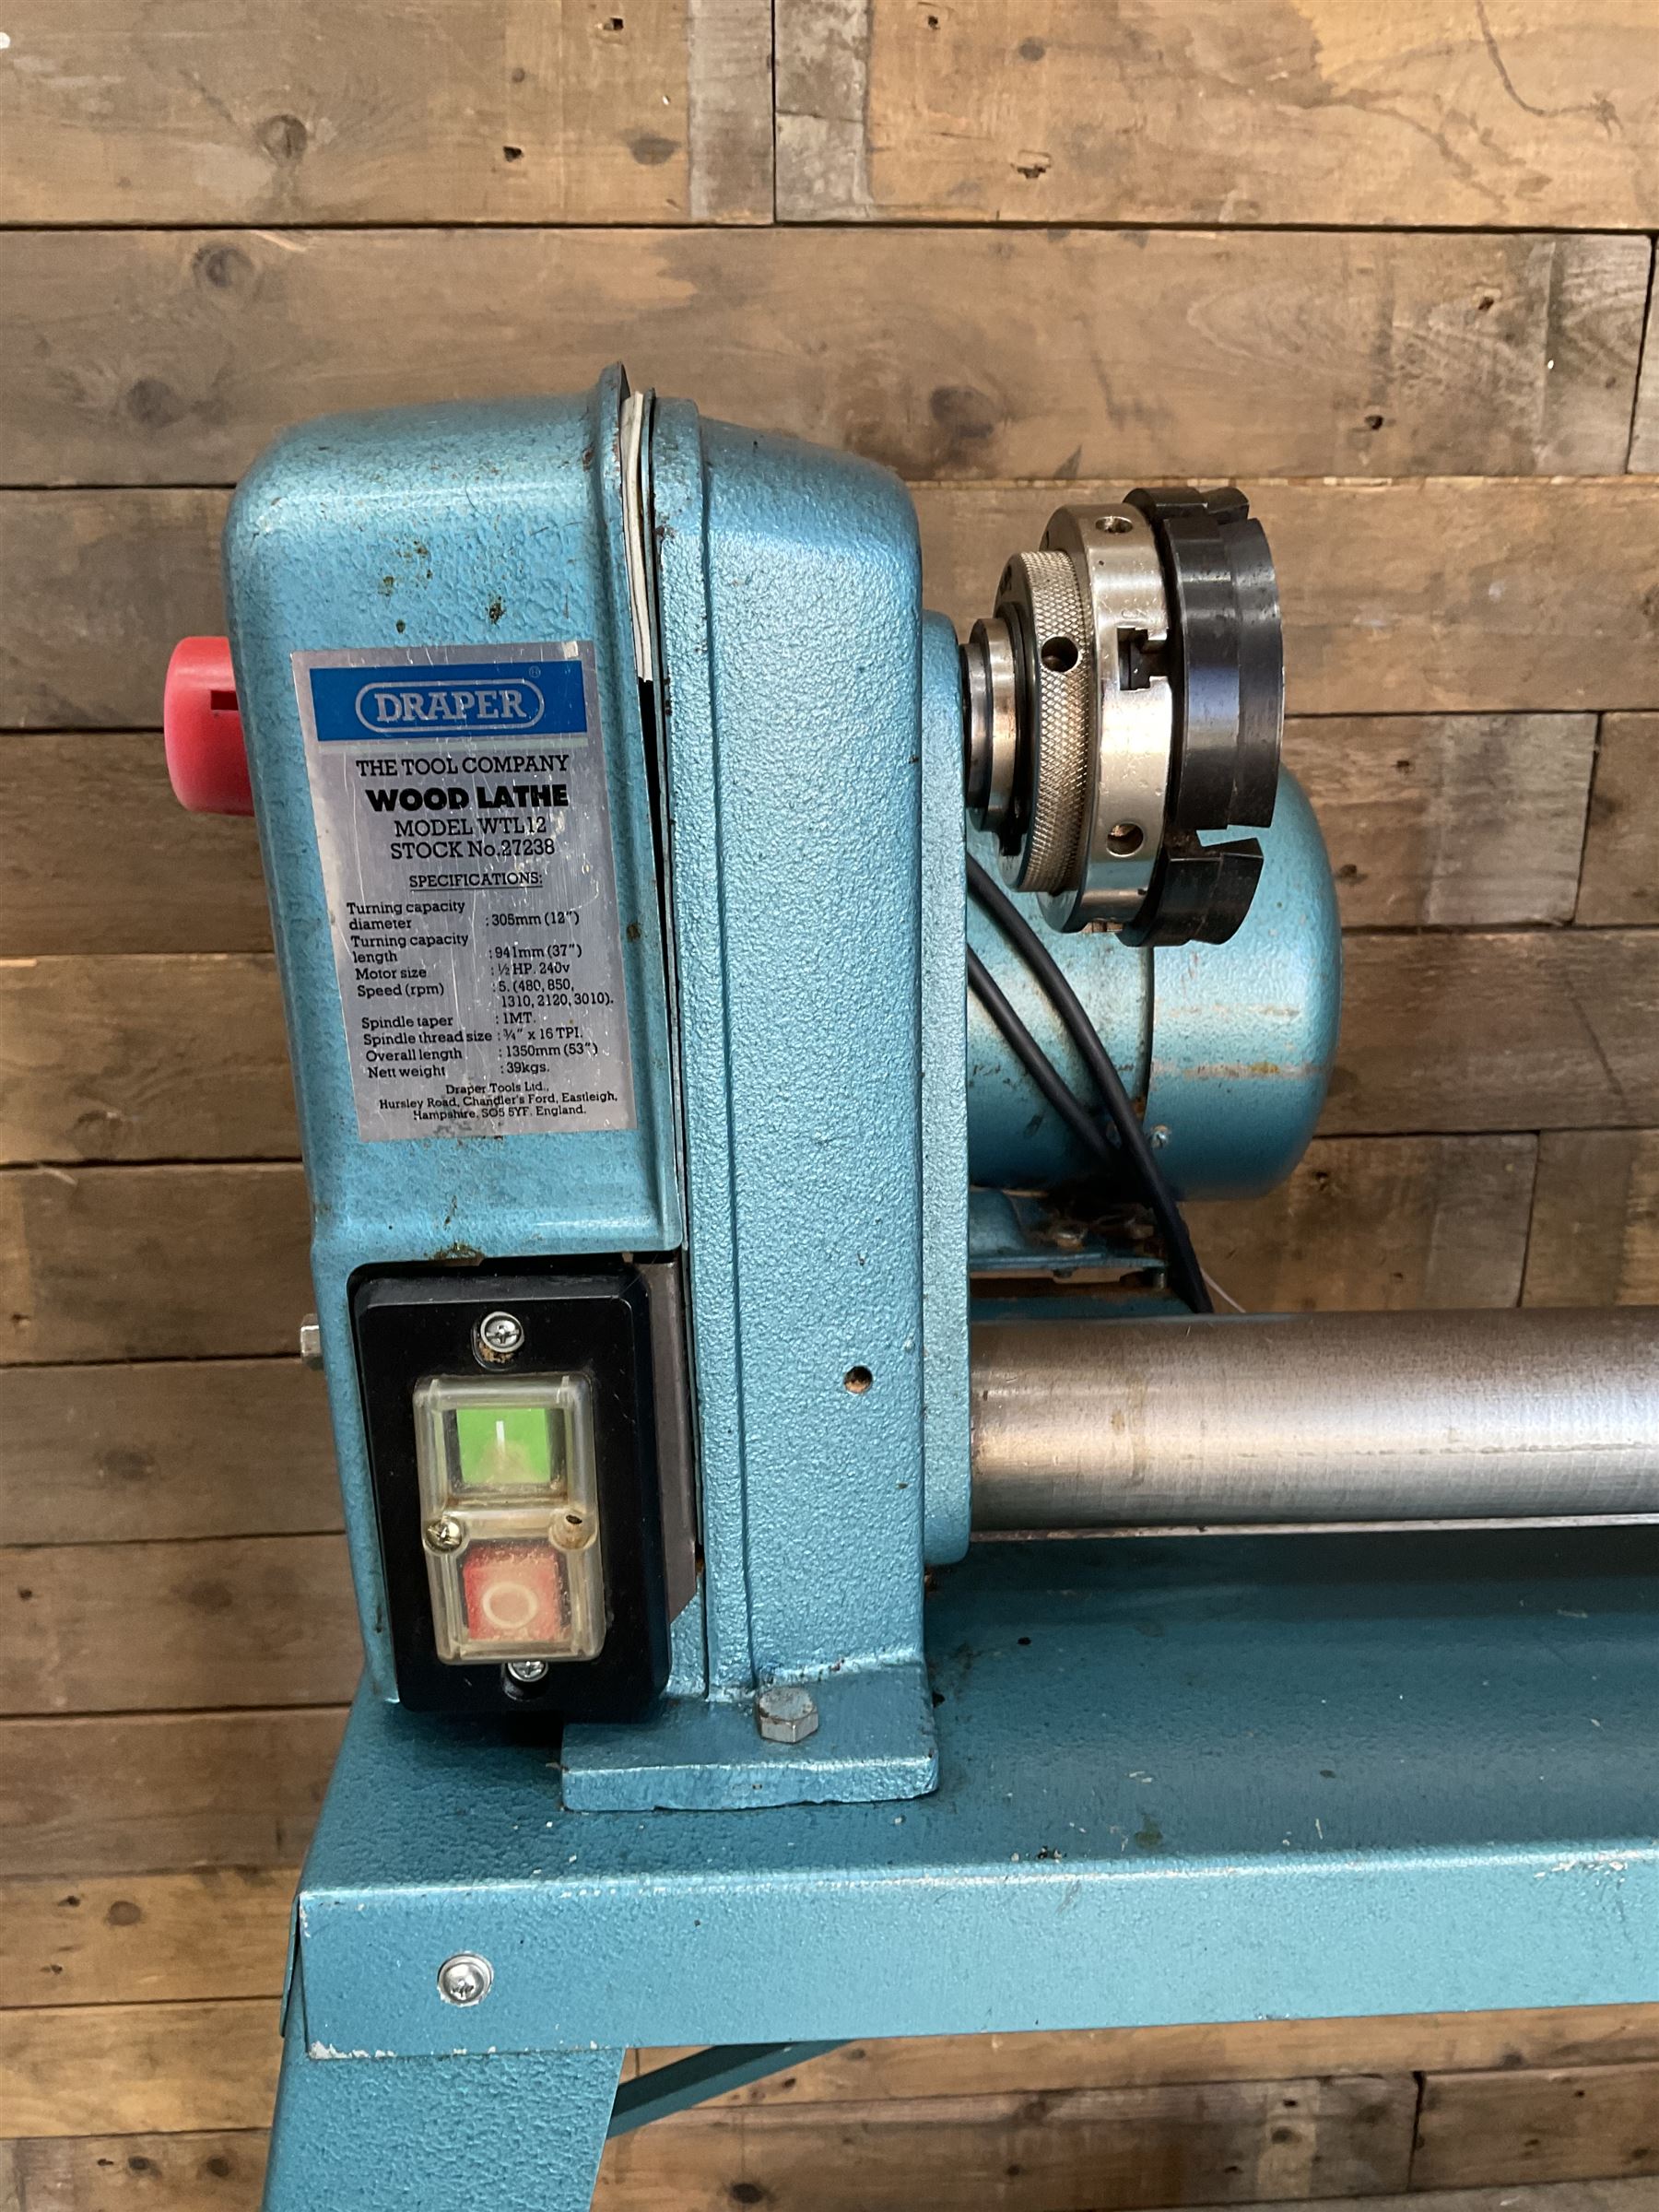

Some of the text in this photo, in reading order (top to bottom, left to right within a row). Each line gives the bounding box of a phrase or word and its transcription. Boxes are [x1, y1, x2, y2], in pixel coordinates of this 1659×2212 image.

[373, 689, 528, 723] DRAPER
[356, 754, 570, 777] THE TOOL COMPANY
[365, 783, 569, 812] WOOD LATHE
[394, 818, 474, 838] MODEL
[390, 841, 463, 860] STOCK
[409, 871, 543, 888] SPECIFICATIONS:
[347, 900, 465, 914] Turning capacity
[348, 917, 412, 931] diameter
[491, 912, 542, 926] 305mm
[350, 932, 469, 948] Turning capacity
[352, 949, 398, 965] length
[495, 946, 545, 959] 941mm
[355, 967, 397, 981] Motor
[400, 966, 427, 979] size
[539, 961, 571, 975] 240v
[357, 982, 403, 999] Speed
[405, 982, 444, 998] (rpm)
[512, 979, 545, 994] (480,
[547, 978, 574, 992] 850,
[501, 992, 615, 1008] 1310, 2120, 3010).
[361, 1016, 415, 1031] Spindle
[417, 1016, 453, 1030] taper
[363, 1032, 417, 1048] Spindle
[418, 1031, 465, 1044] thread
[465, 1030, 493, 1042] size
[527, 1030, 536, 1041] x
[539, 1028, 554, 1040] 16
[555, 1026, 583, 1039] TPI.
[365, 1049, 417, 1063] Overall
[418, 1047, 463, 1062] length
[506, 1044, 561, 1058] 1350mm
[368, 1066, 396, 1079] Nett
[398, 1065, 446, 1078] weight
[506, 1061, 550, 1075] 39kgs.
[445, 1084, 488, 1096] Draper
[489, 1082, 522, 1094] Tools
[379, 1090, 618, 1110] Hursley Road, Chandler's Ford, Eastleigh,
[535, 1104, 587, 1117] England.
